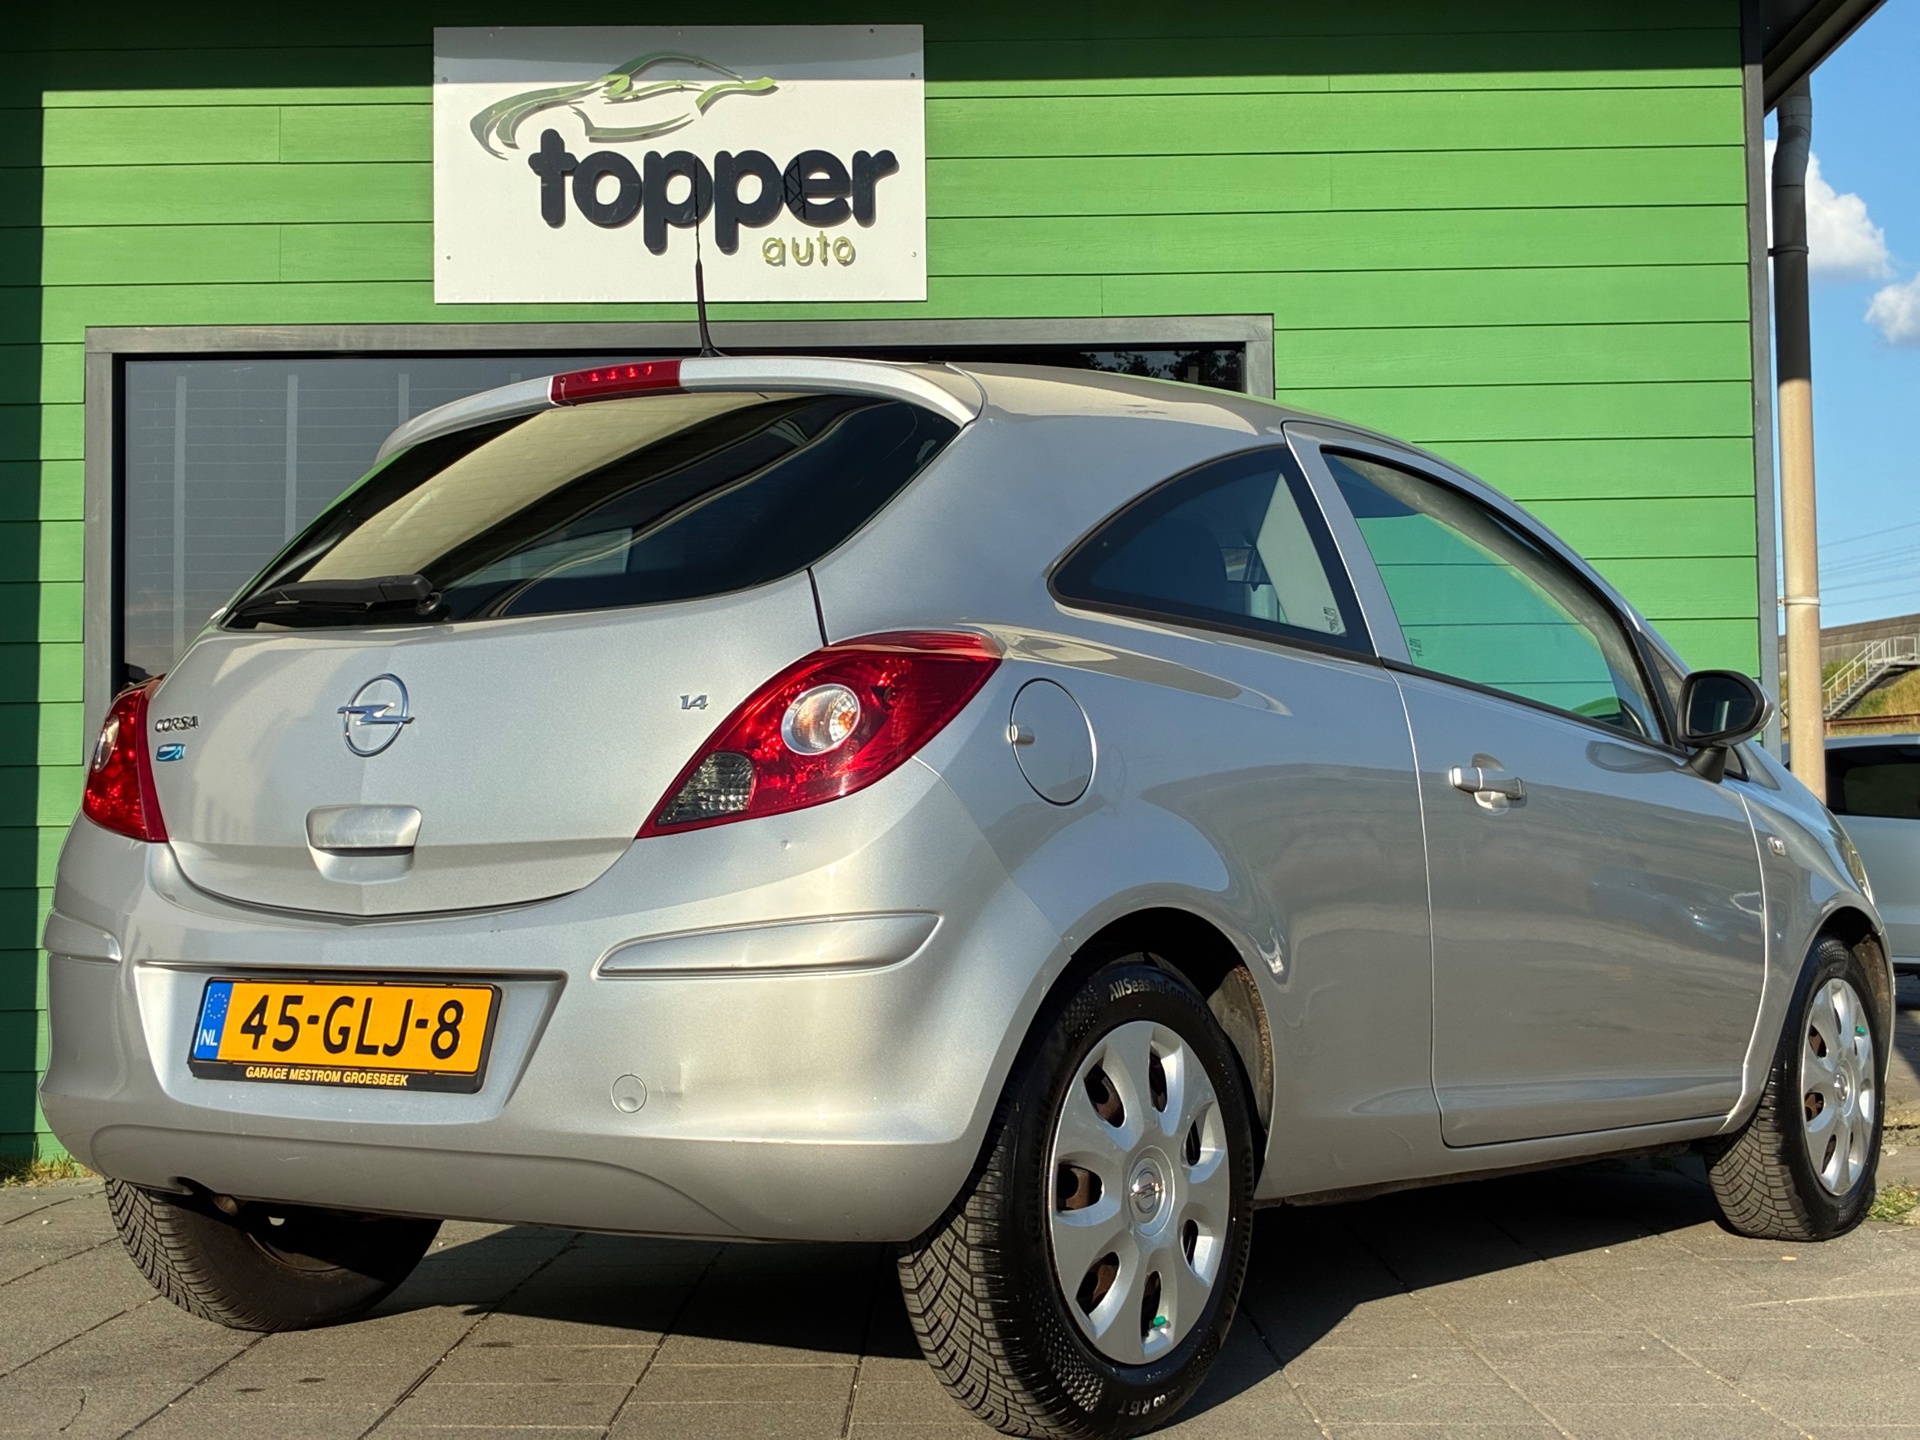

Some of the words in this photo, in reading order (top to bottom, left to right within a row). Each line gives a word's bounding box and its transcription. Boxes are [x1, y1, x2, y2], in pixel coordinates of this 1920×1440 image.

[528, 129, 898, 255] topper
[763, 232, 854, 265] auto
[155, 716, 199, 733] CORSA
[201, 1029, 218, 1046] NL
[240, 995, 464, 1059] 45-GLJ-8
[246, 1066, 286, 1079] GARAGE
[289, 1069, 341, 1083] MESTROM
[343, 1072, 408, 1086] GROESBEEK
